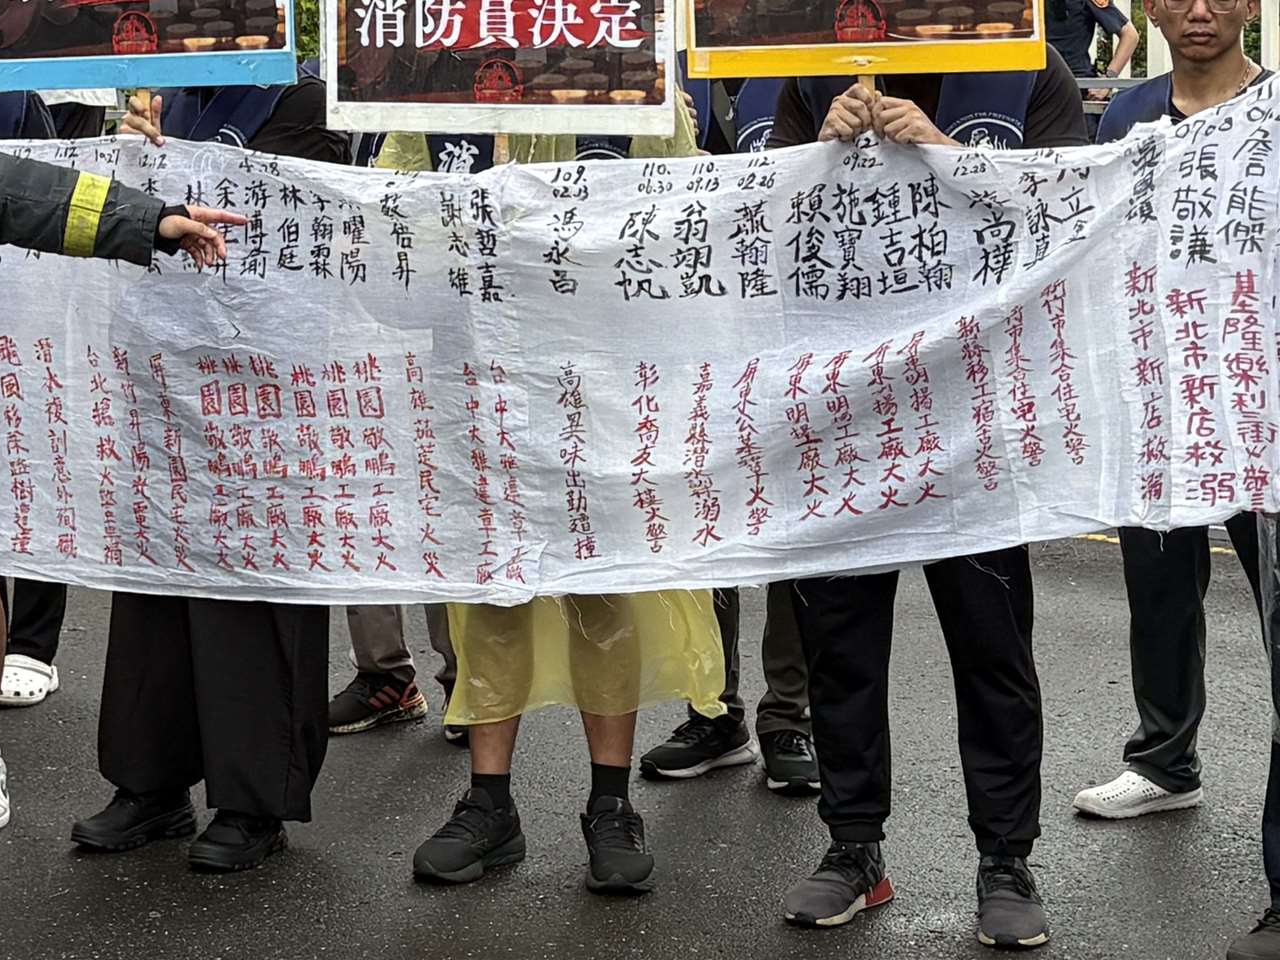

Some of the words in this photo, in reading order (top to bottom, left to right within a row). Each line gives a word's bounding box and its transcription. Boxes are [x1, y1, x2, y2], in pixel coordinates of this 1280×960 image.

[277, 184, 306, 271] 林伯庭
[338, 198, 371, 286] 曜陽
[785, 183, 832, 300] 賴俊儒
[831, 181, 871, 302] 施寶翔
[1172, 143, 1219, 269] 張敬謙
[862, 339, 912, 510] 屏東揚工廠大火
[1165, 288, 1237, 507] 新北市新店救溺
